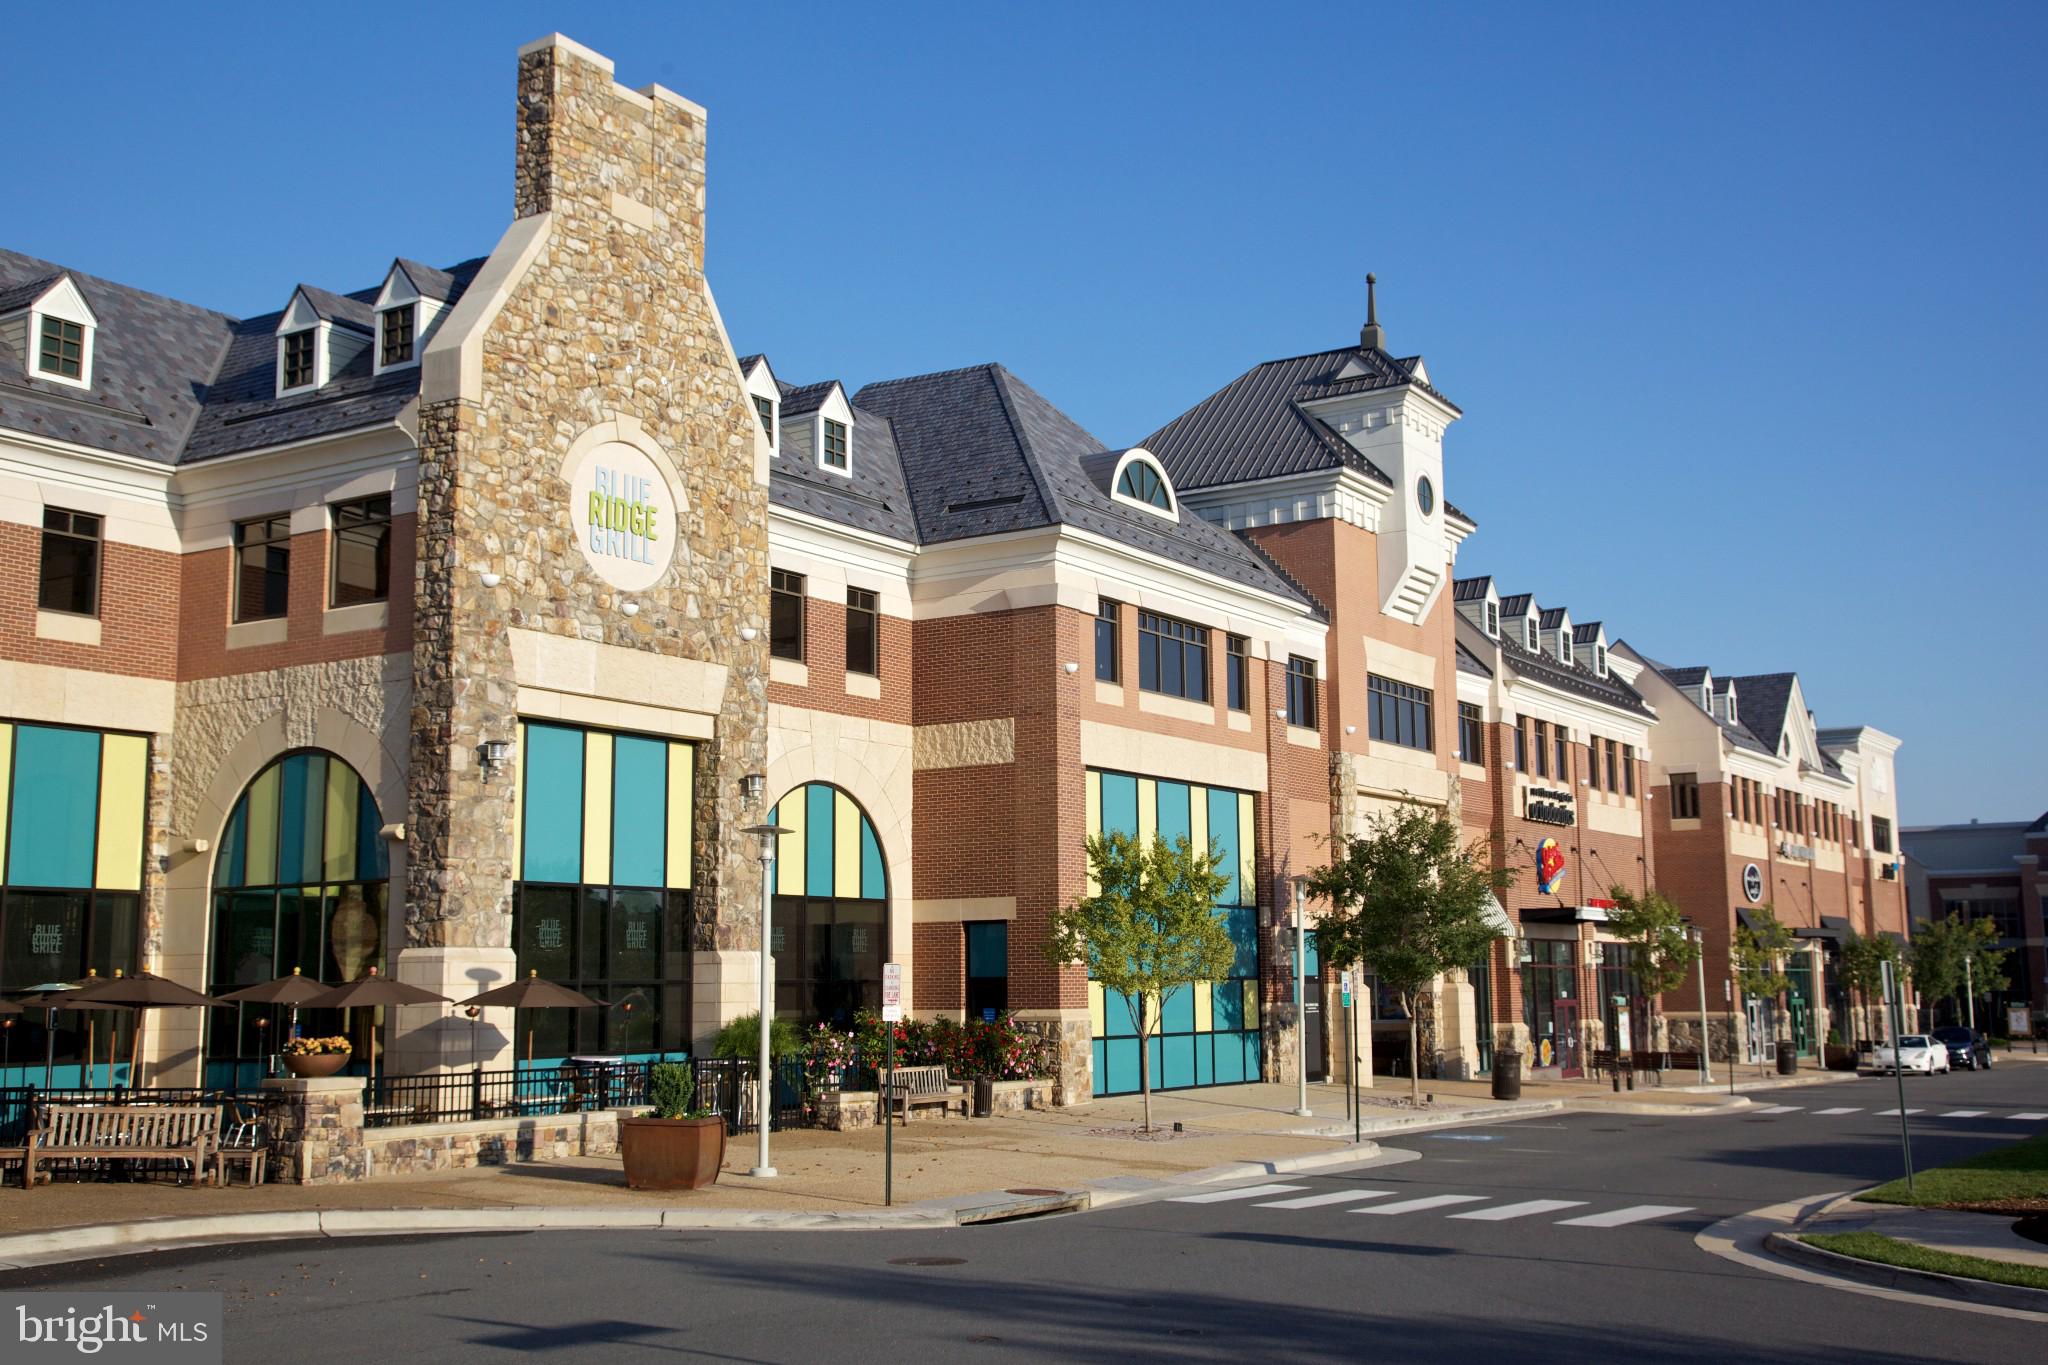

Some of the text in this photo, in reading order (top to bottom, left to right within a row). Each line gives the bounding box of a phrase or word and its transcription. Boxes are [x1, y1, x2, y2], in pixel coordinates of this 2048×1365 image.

[595, 464, 654, 511] BLUE
[588, 491, 659, 541] RIDGE
[590, 522, 656, 566] GRILL
